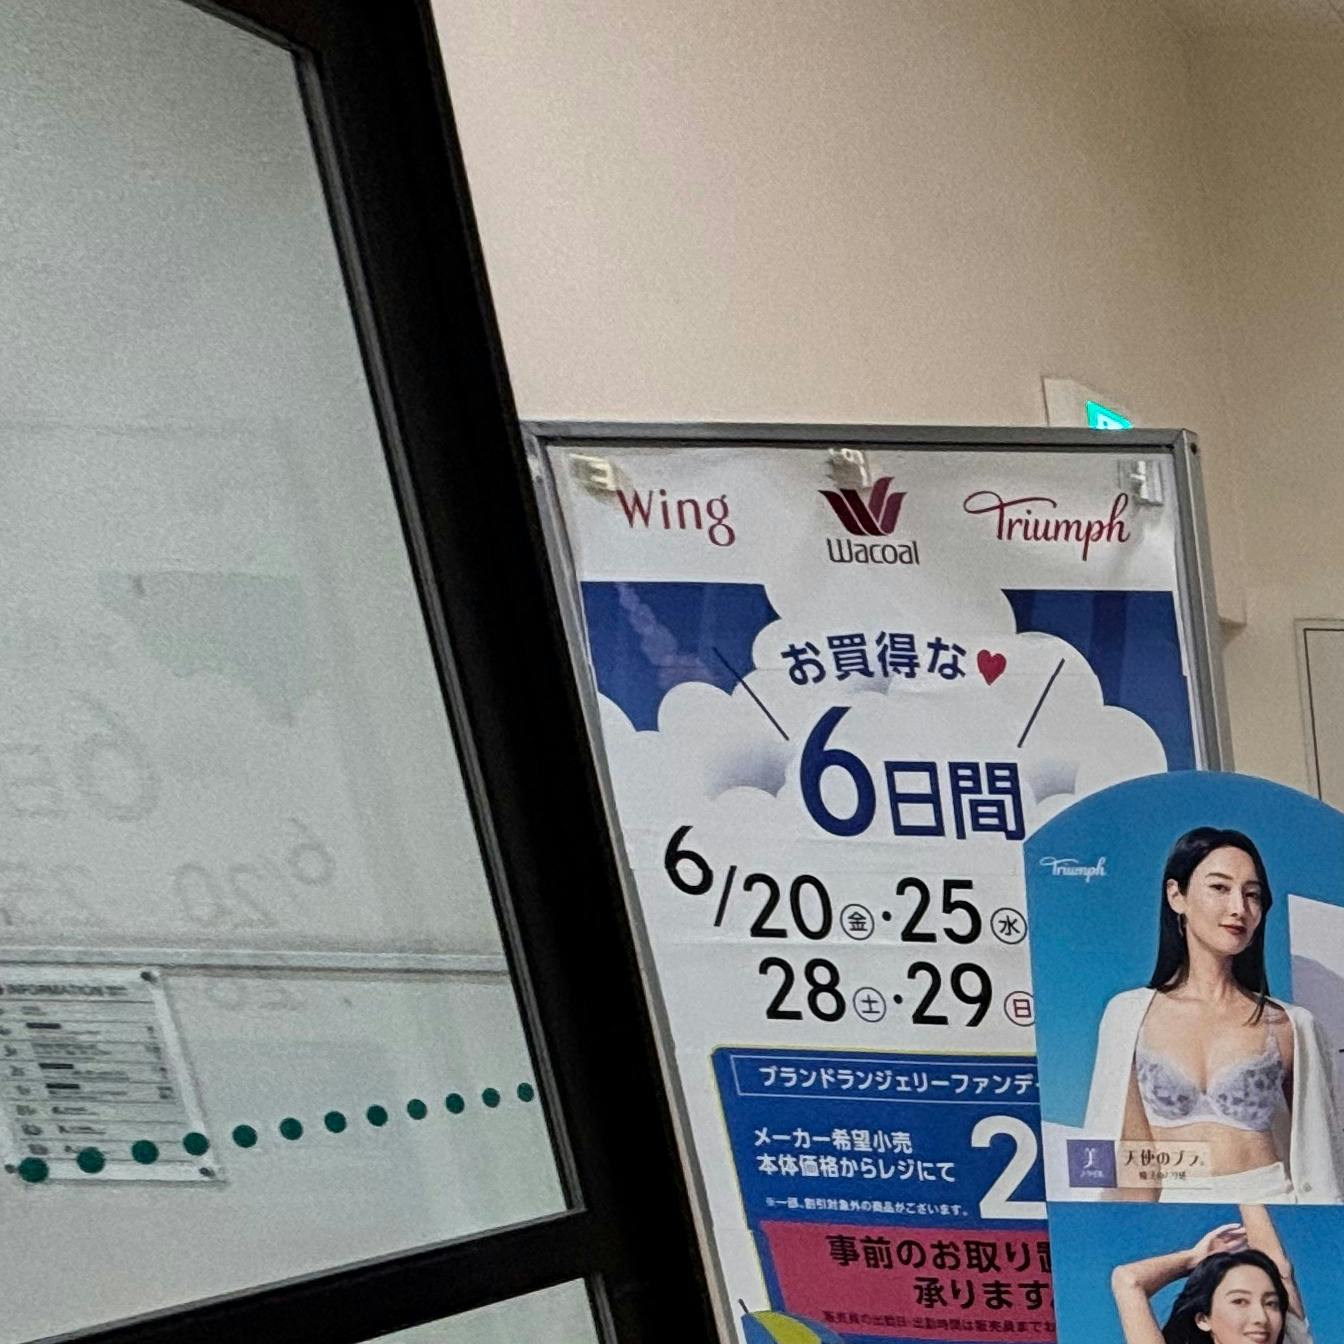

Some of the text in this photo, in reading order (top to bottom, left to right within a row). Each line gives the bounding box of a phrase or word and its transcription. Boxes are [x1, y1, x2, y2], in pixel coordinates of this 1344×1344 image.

[614, 488, 736, 548] Wing
[963, 490, 1132, 560] Triumph
[826, 538, 921, 566] Wacoal
[780, 630, 968, 686] お買得な
[801, 706, 1026, 840] 6日間
[1039, 857, 1107, 883] Triumph
[758, 1065, 1040, 1096] ブランドランジェリーファンデ
[754, 1127, 913, 1154] メーカー希望小売
[756, 1152, 957, 1183] 本体価格からレジにて
